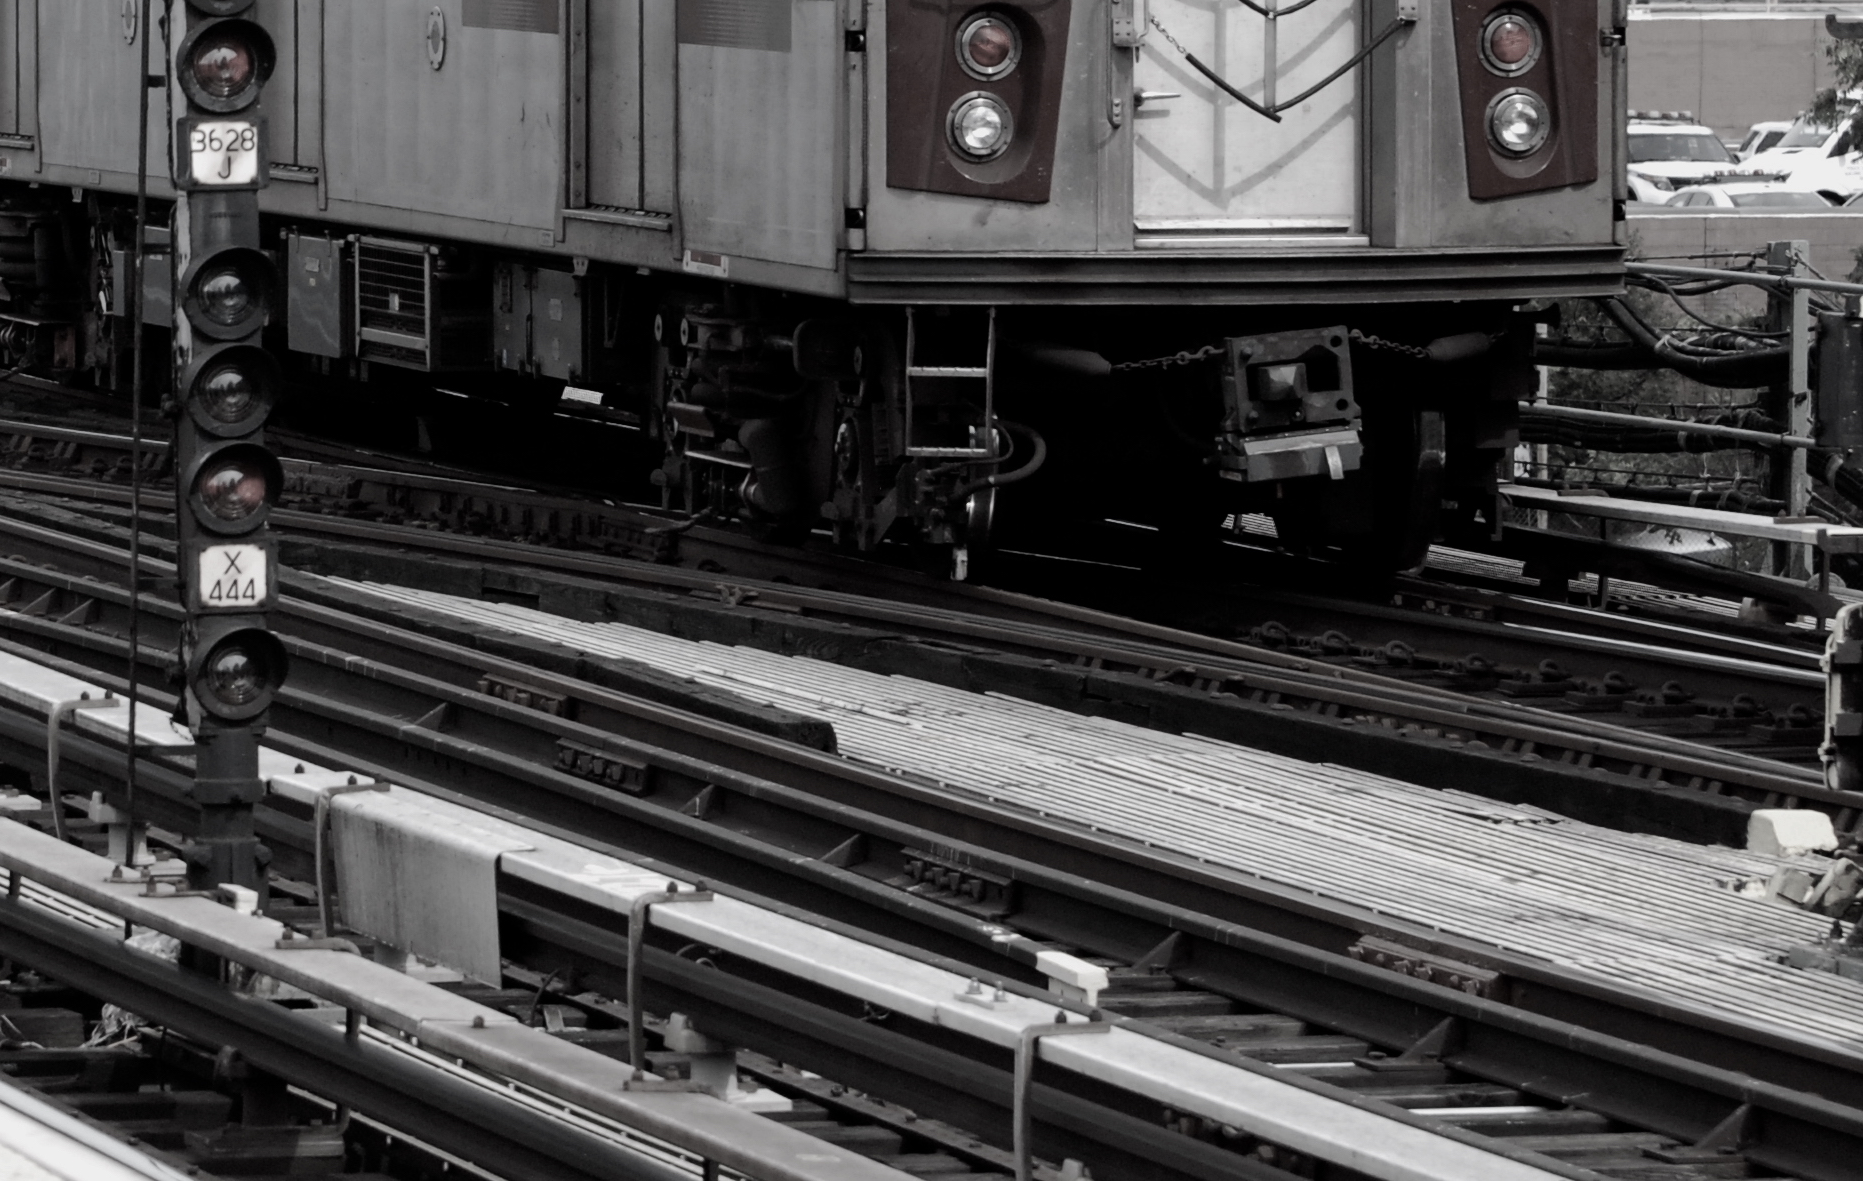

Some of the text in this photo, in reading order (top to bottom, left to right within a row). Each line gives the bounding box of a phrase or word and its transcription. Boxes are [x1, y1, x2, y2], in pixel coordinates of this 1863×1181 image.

[191, 128, 255, 153] 3628
[218, 156, 231, 179] J
[224, 551, 242, 575] X
[209, 578, 255, 601] 444
